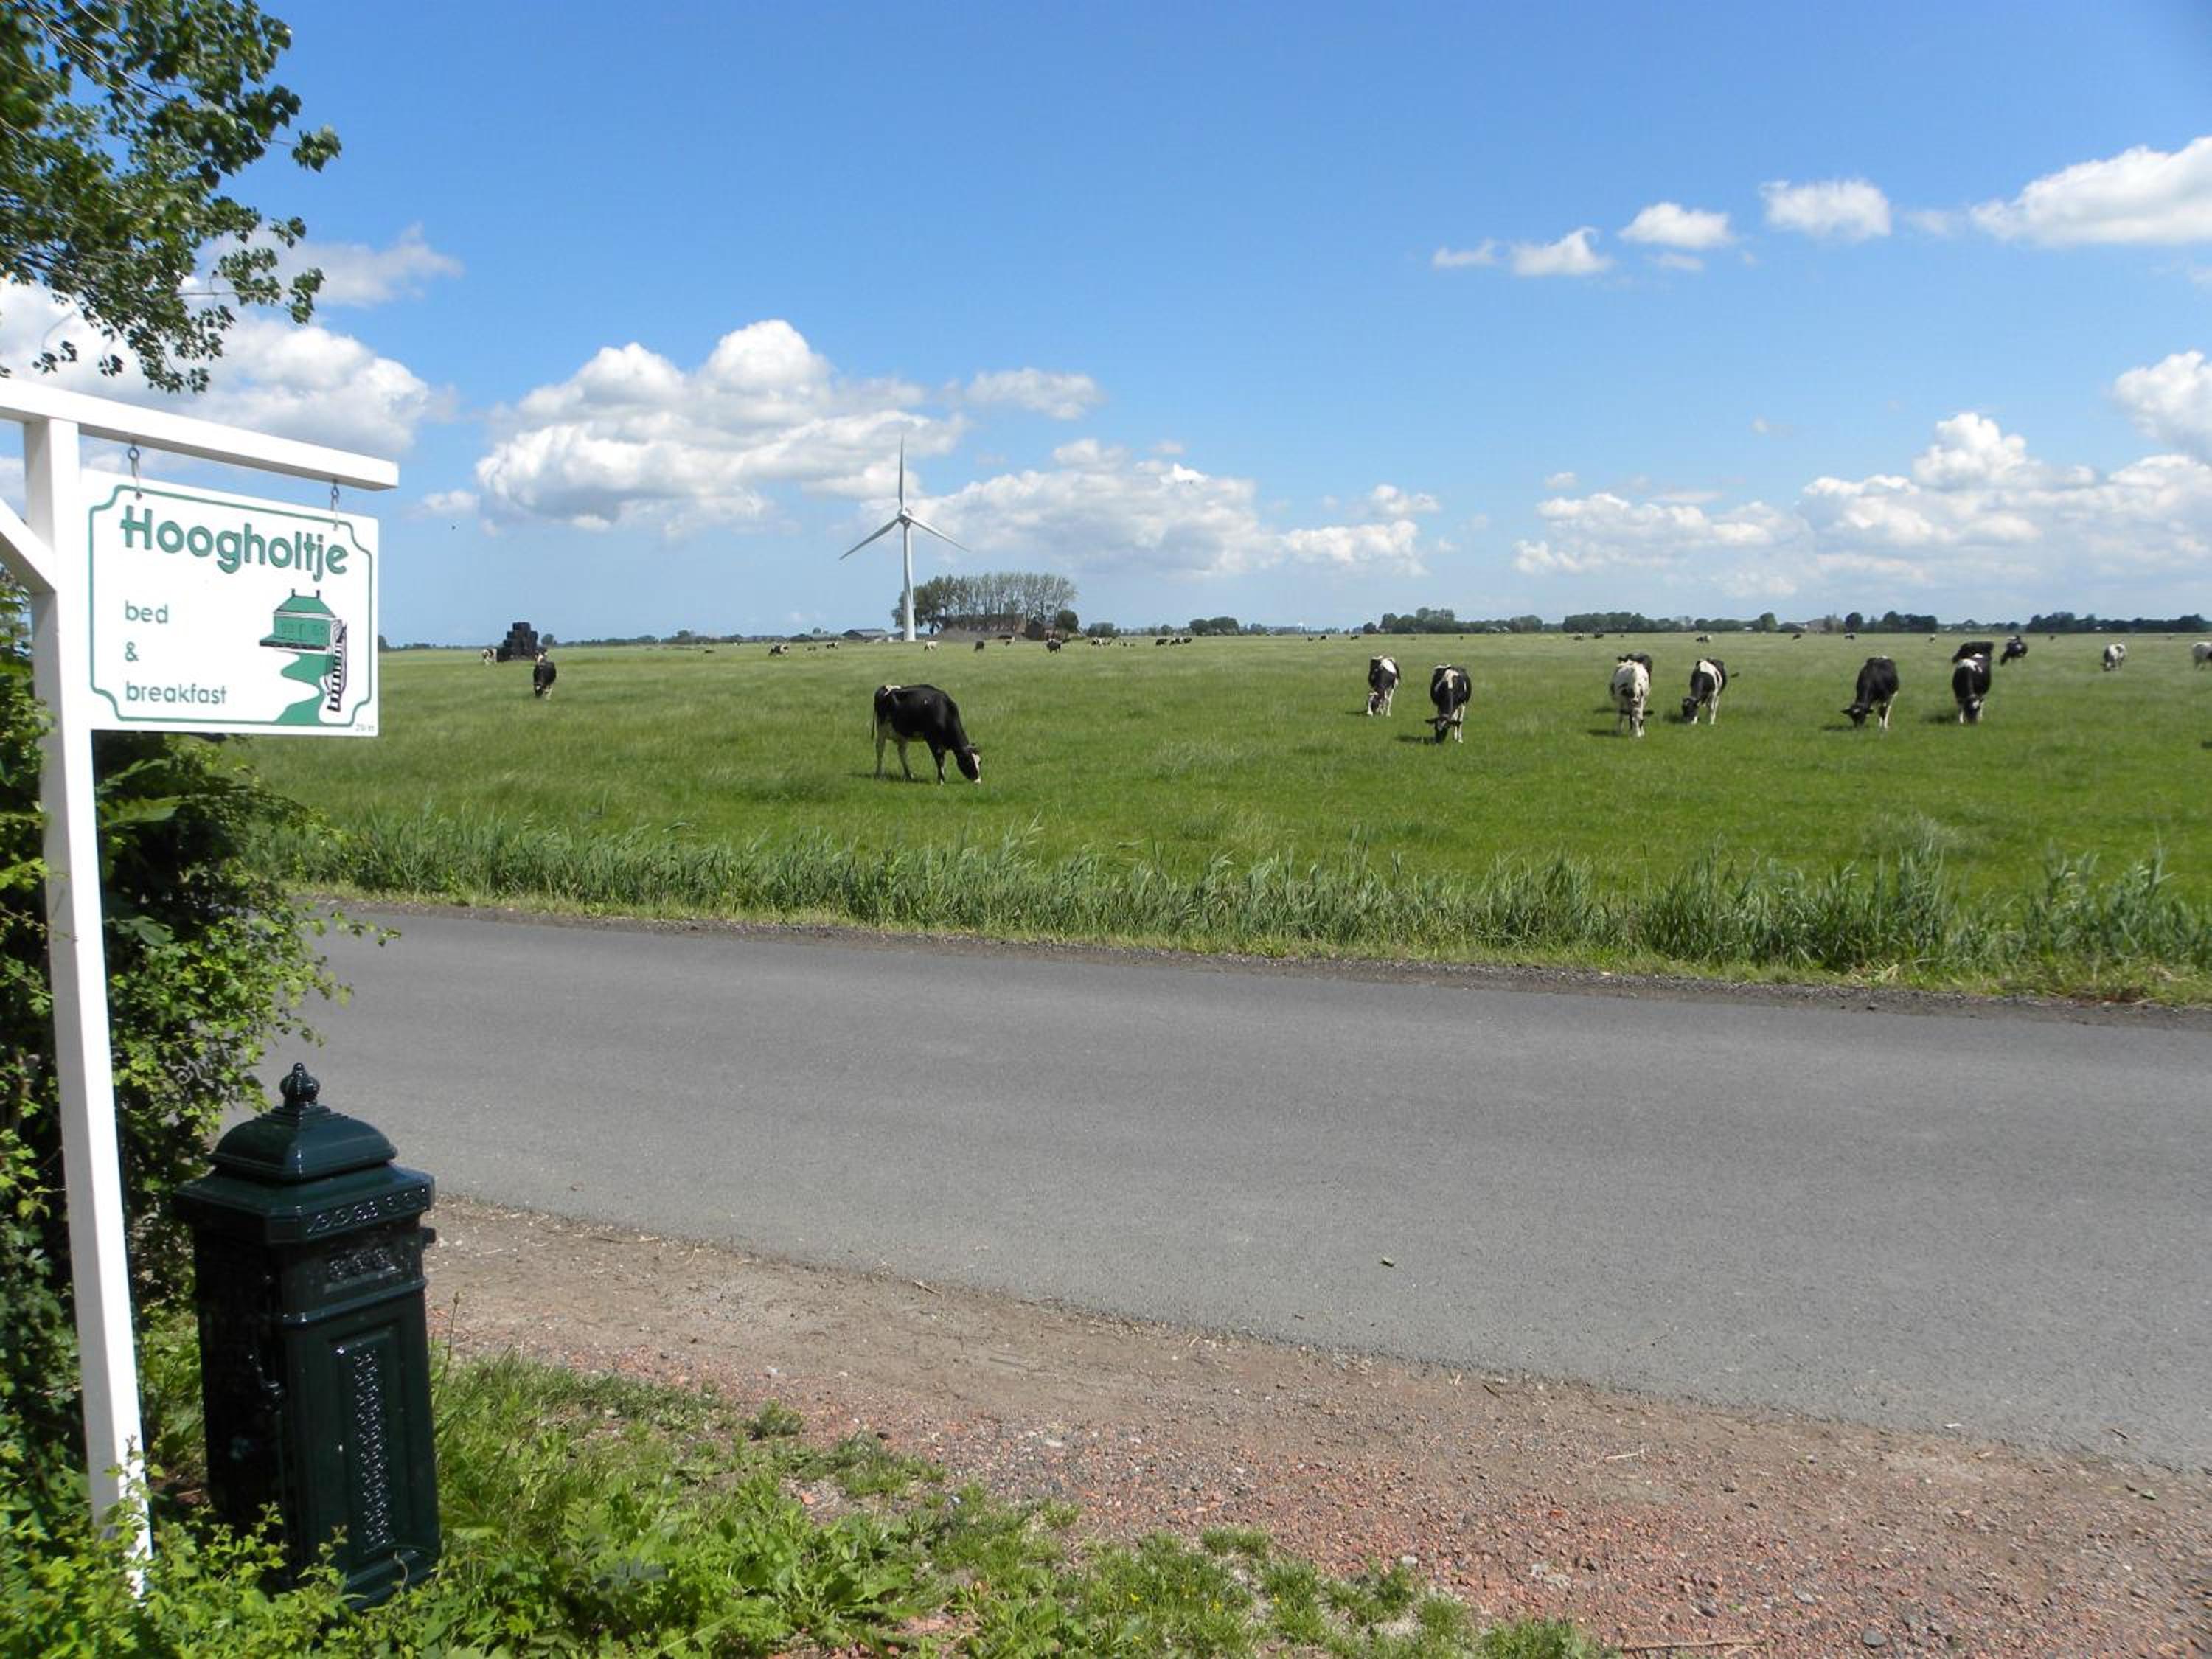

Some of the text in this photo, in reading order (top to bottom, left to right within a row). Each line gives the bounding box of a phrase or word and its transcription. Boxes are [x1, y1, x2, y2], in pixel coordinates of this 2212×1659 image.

[119, 505, 349, 582] Hoogholtje
[125, 601, 169, 624] bed
[125, 641, 139, 662] &
[125, 681, 227, 704] breakfast
